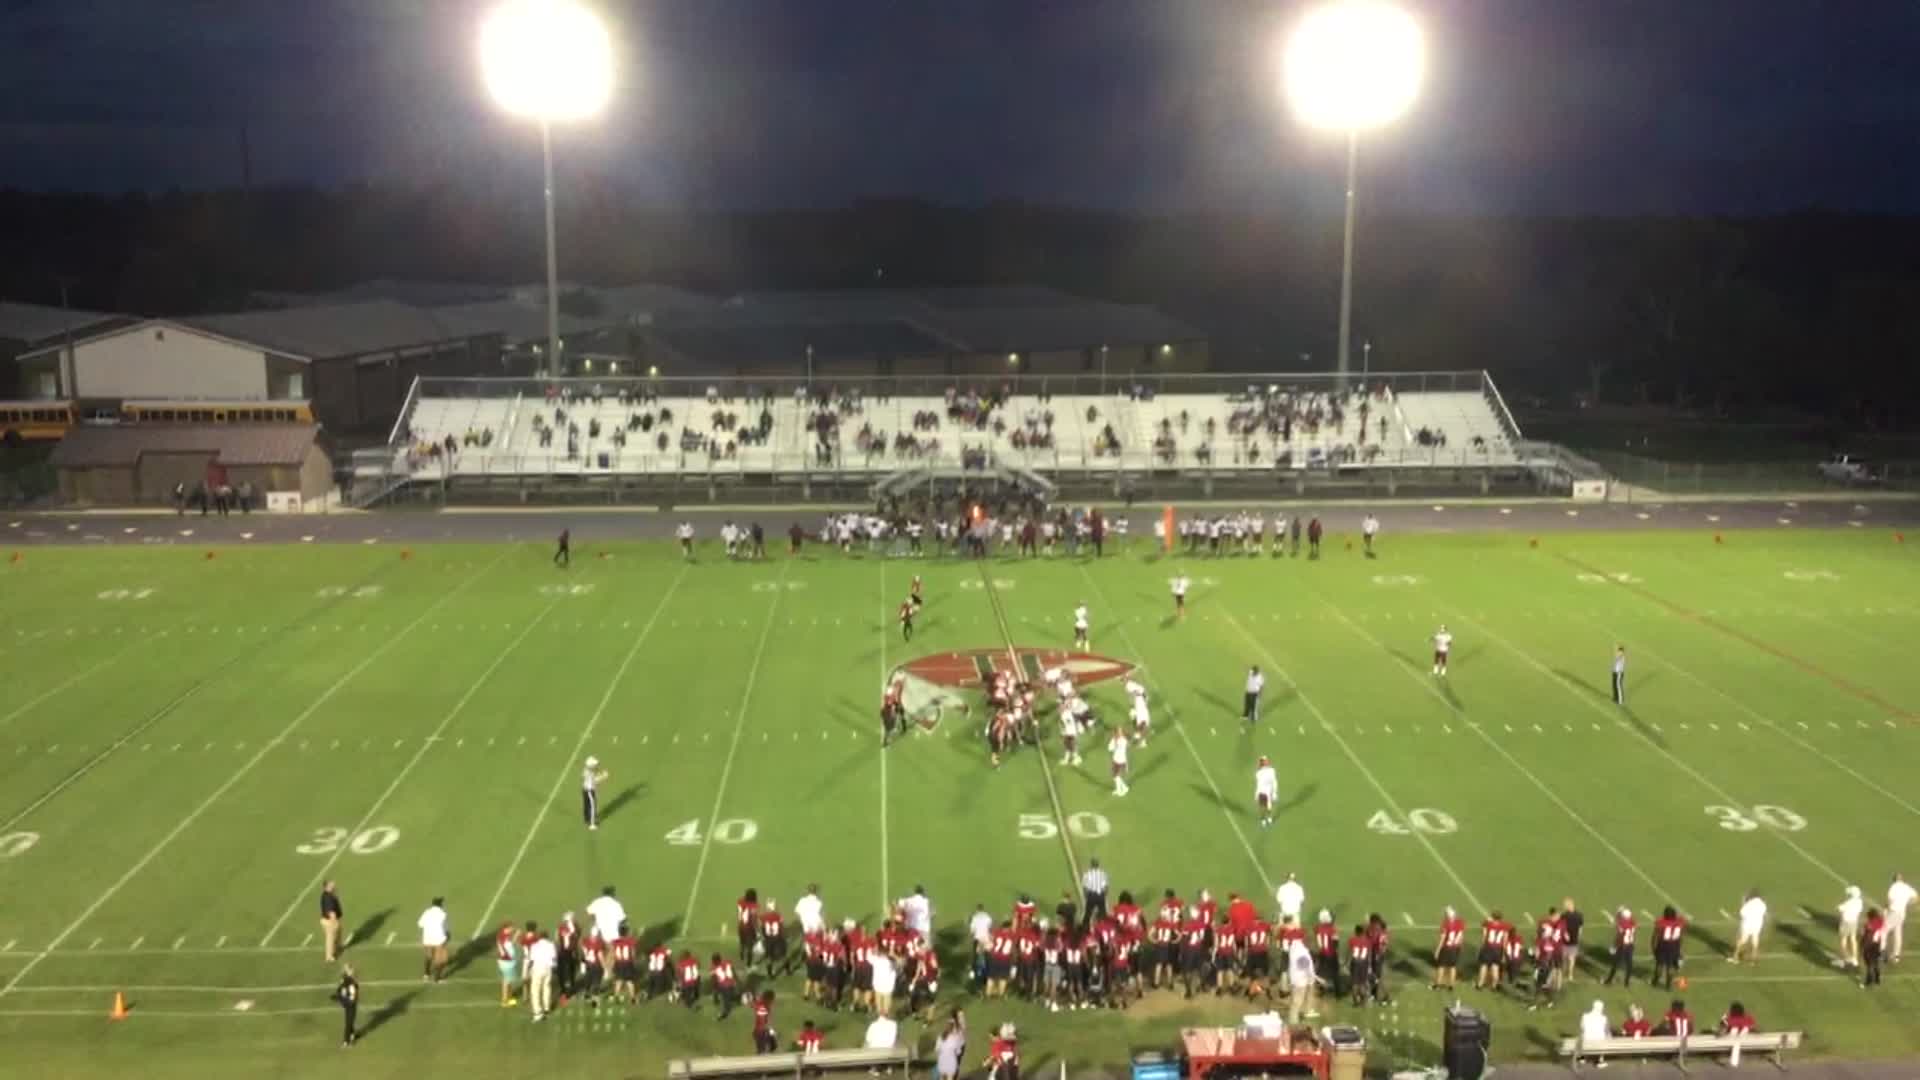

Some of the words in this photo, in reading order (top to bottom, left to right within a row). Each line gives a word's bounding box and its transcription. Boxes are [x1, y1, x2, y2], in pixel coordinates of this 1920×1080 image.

[664, 818, 758, 846] 40
[1017, 812, 1111, 840] 50
[1367, 808, 1459, 835] 40
[1703, 804, 1809, 832] 30
[296, 825, 401, 855] 30
